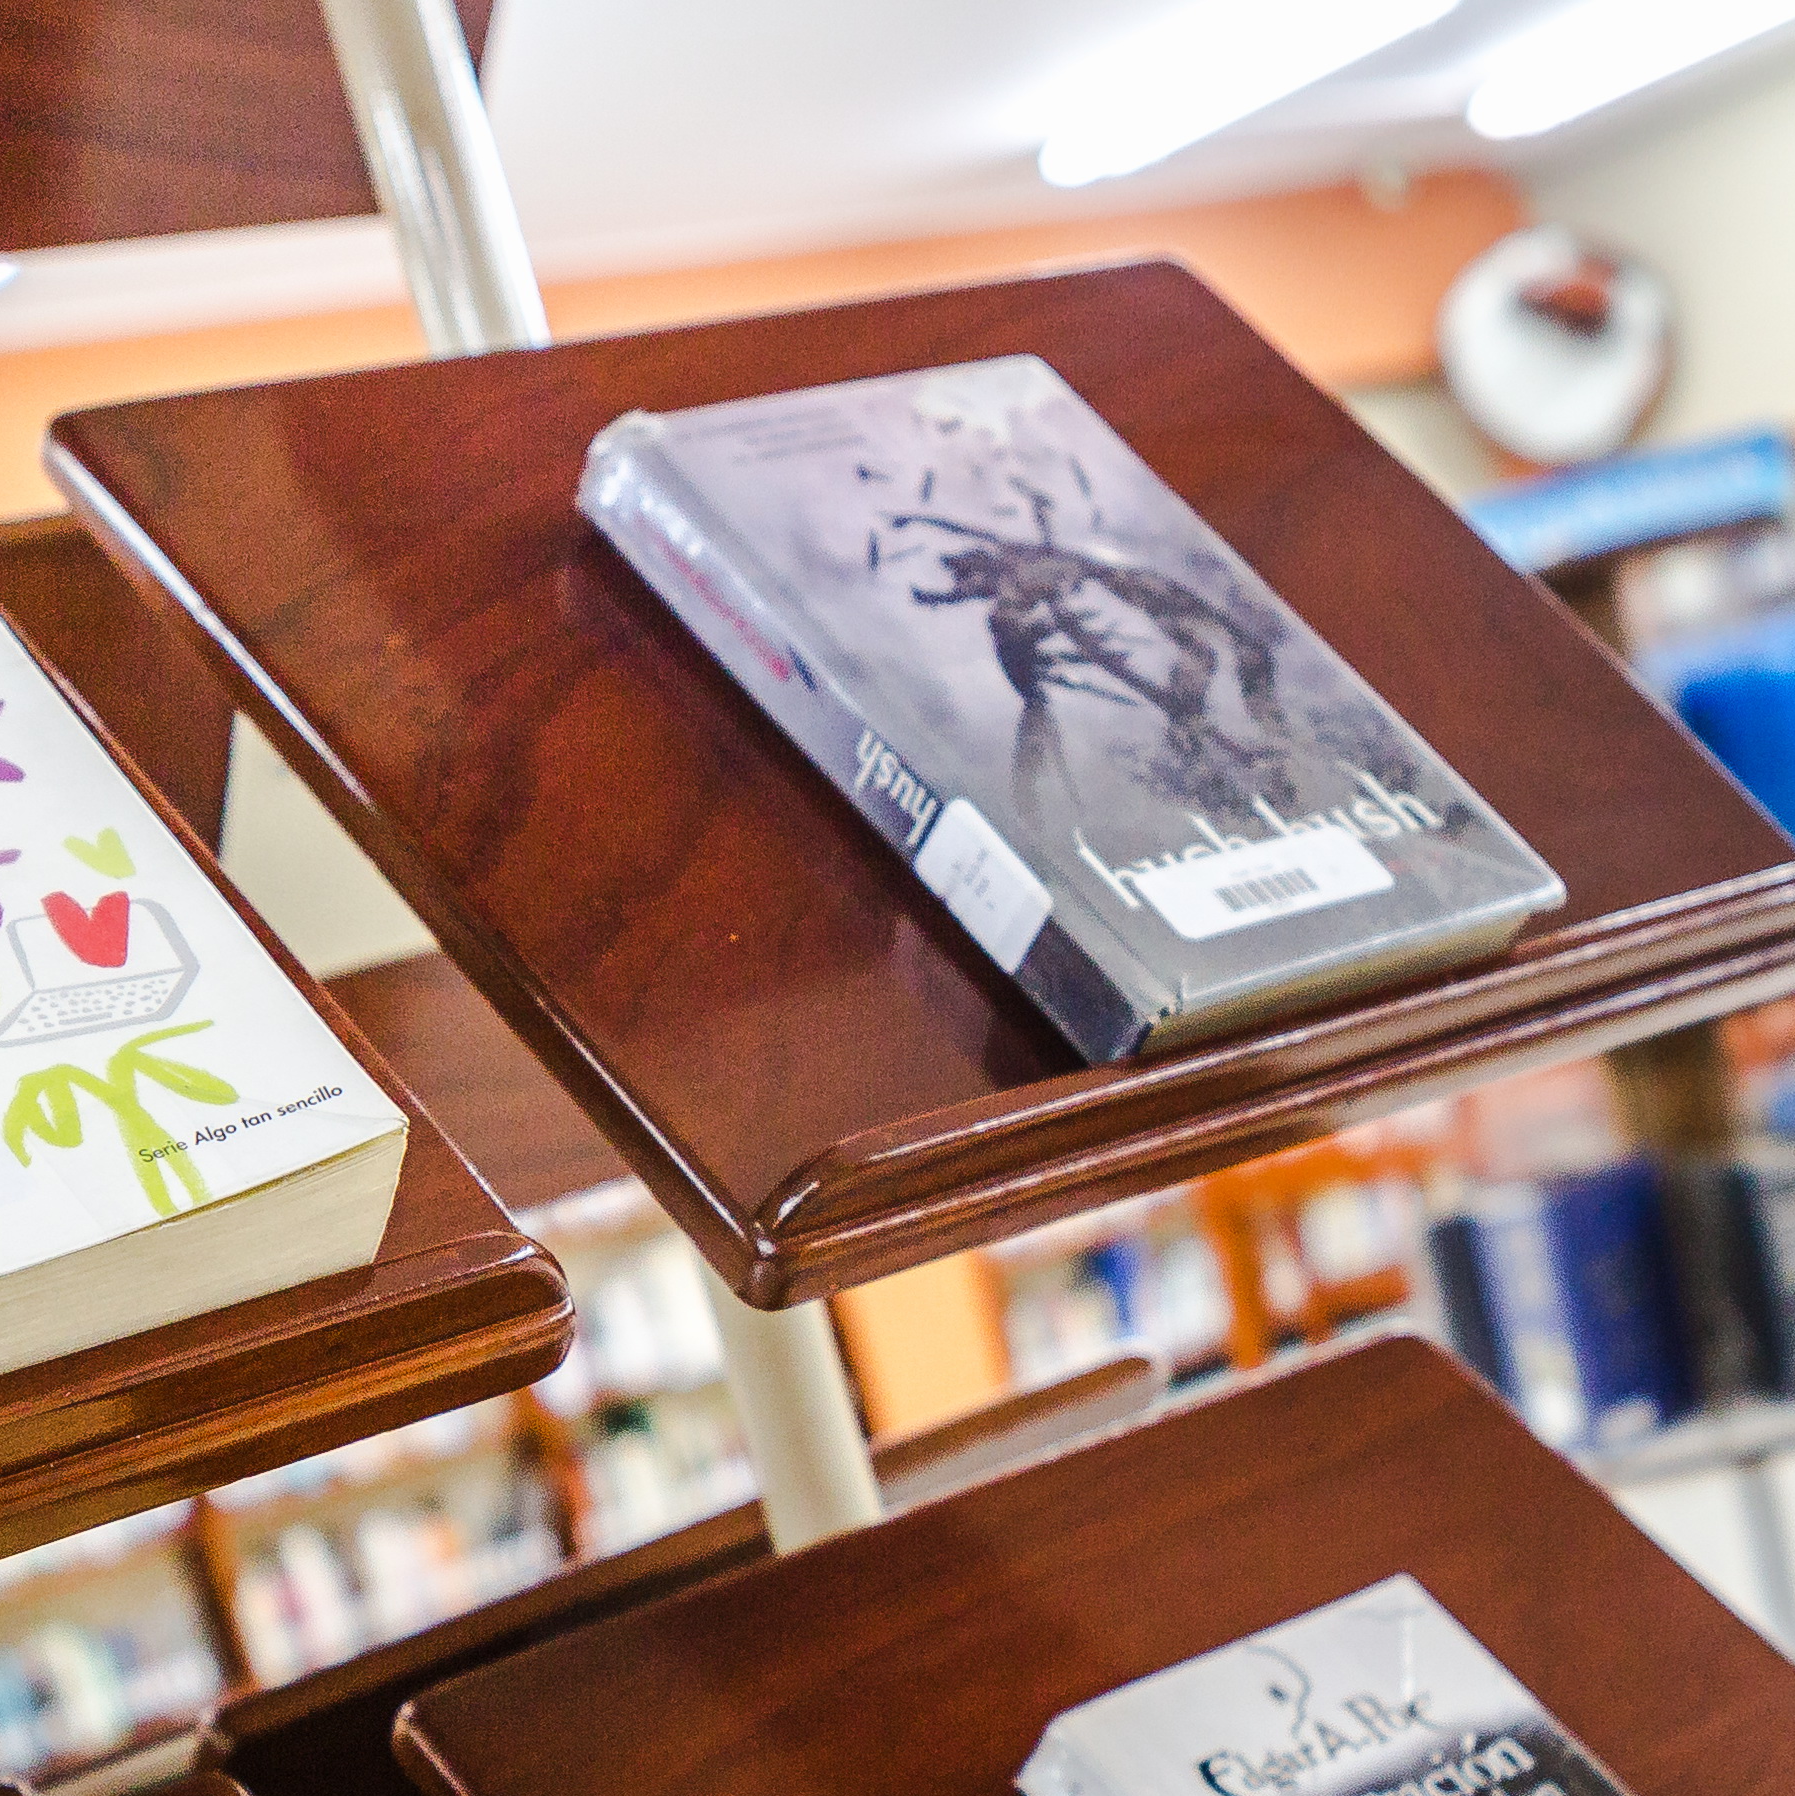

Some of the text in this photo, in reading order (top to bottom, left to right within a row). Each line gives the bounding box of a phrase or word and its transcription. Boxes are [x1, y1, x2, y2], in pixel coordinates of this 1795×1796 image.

[137, 1083, 345, 1165] Serie Algo tan sencillo
